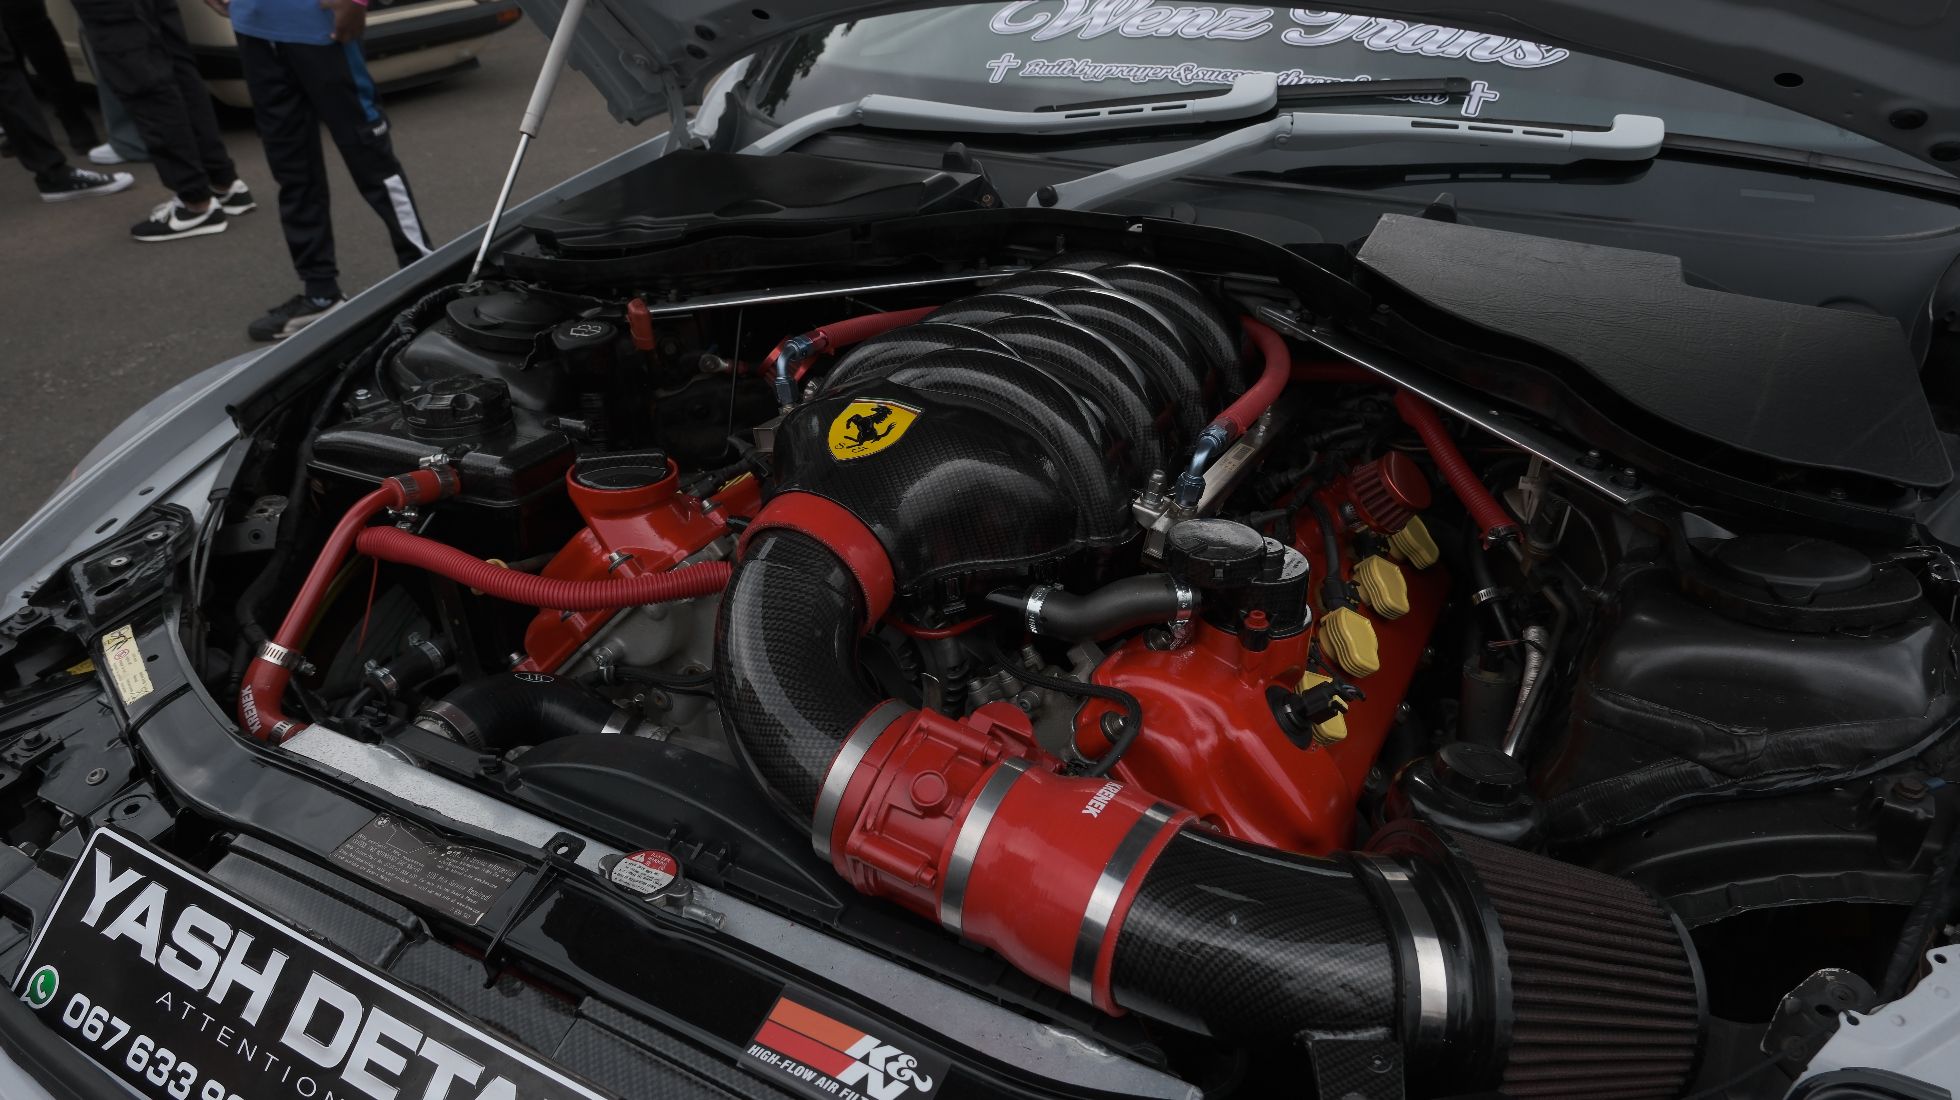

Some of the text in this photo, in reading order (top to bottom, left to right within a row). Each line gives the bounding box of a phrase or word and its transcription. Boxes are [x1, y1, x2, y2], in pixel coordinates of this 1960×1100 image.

[989, 0, 1274, 41] Wenz
[241, 685, 262, 733] KRENEK
[1081, 781, 1124, 818] KRENEK
[81, 848, 517, 1100] YASH DET
[62, 992, 132, 1051] 067
[125, 1034, 199, 1100] 633
[747, 1044, 818, 1082] HIGH-FLOW
[815, 1076, 840, 1094] AIR
[835, 1034, 933, 1100] K&N
